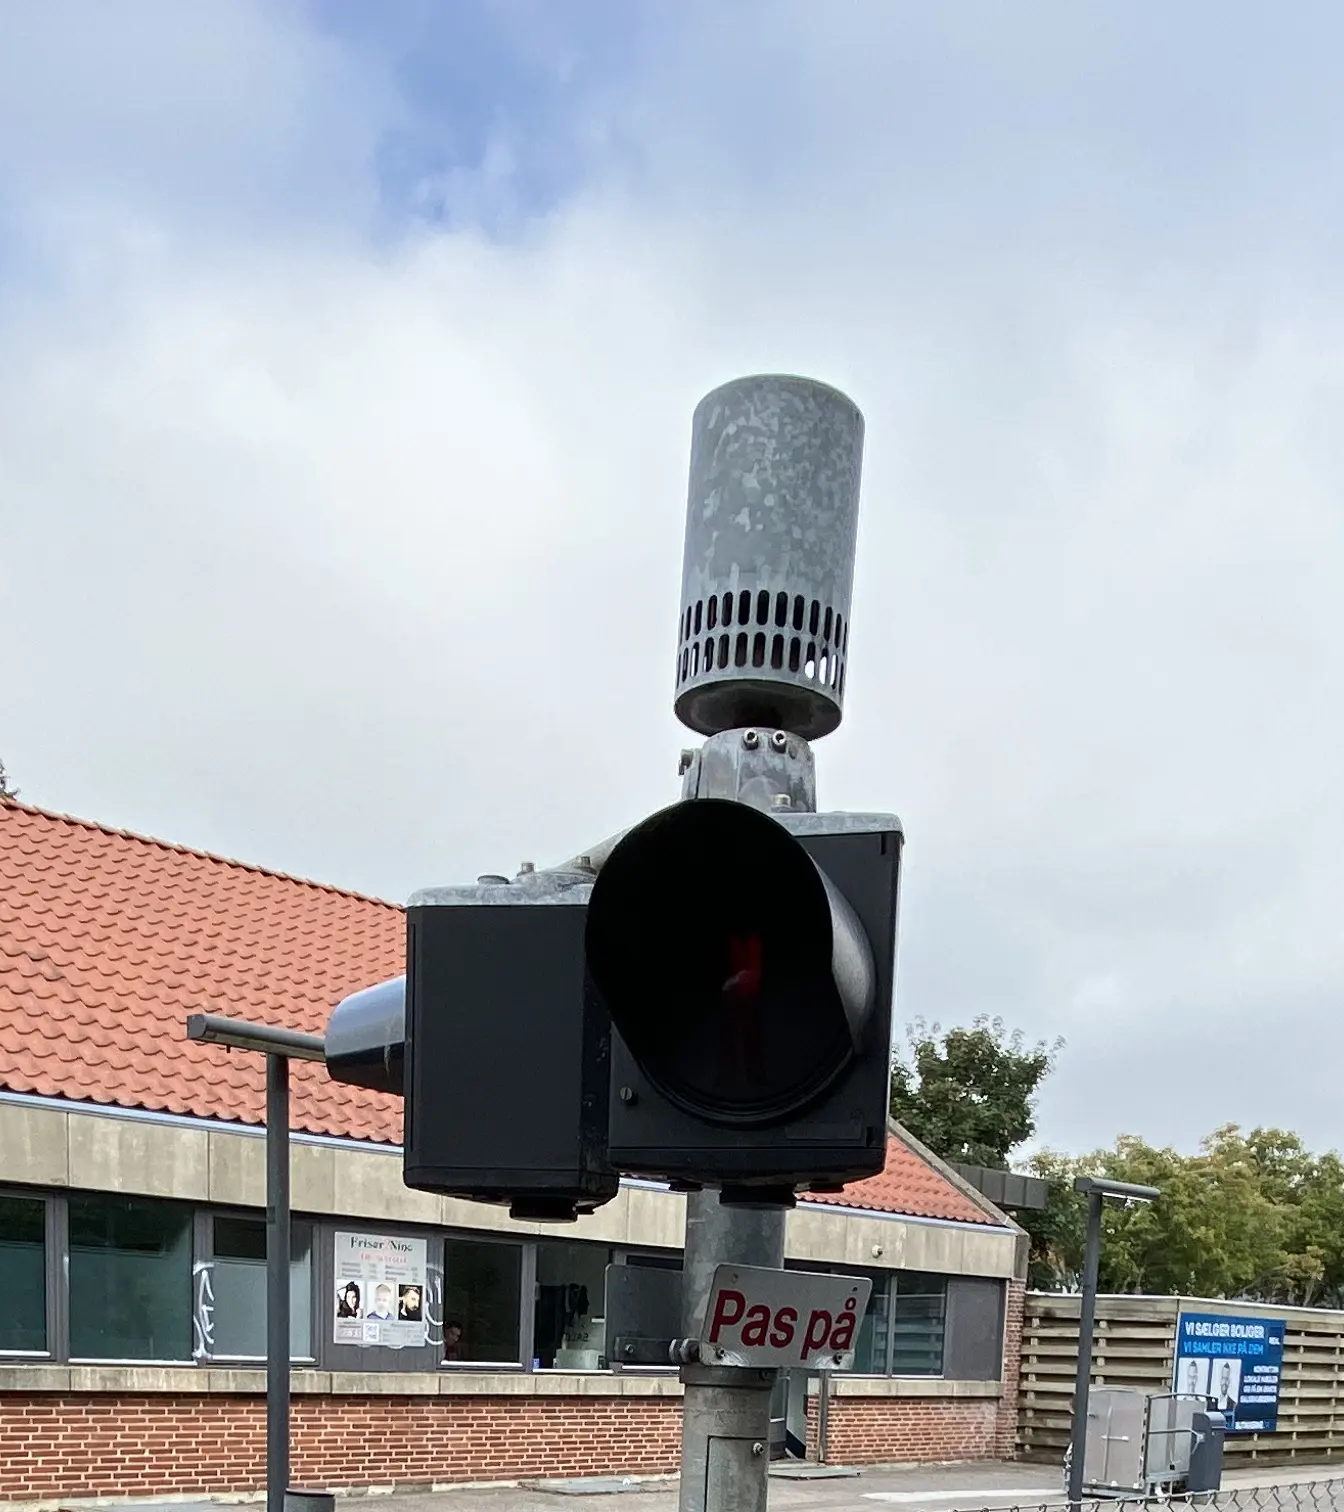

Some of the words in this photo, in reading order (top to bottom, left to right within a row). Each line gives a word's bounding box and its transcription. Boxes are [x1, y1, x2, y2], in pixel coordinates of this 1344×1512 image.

[709, 1289, 798, 1348] Pas
[800, 1297, 857, 1360] på
[1185, 1321, 1194, 1336] VI
[1195, 1322, 1230, 1337] SÆLGER
[1183, 1341, 1192, 1353] VI
